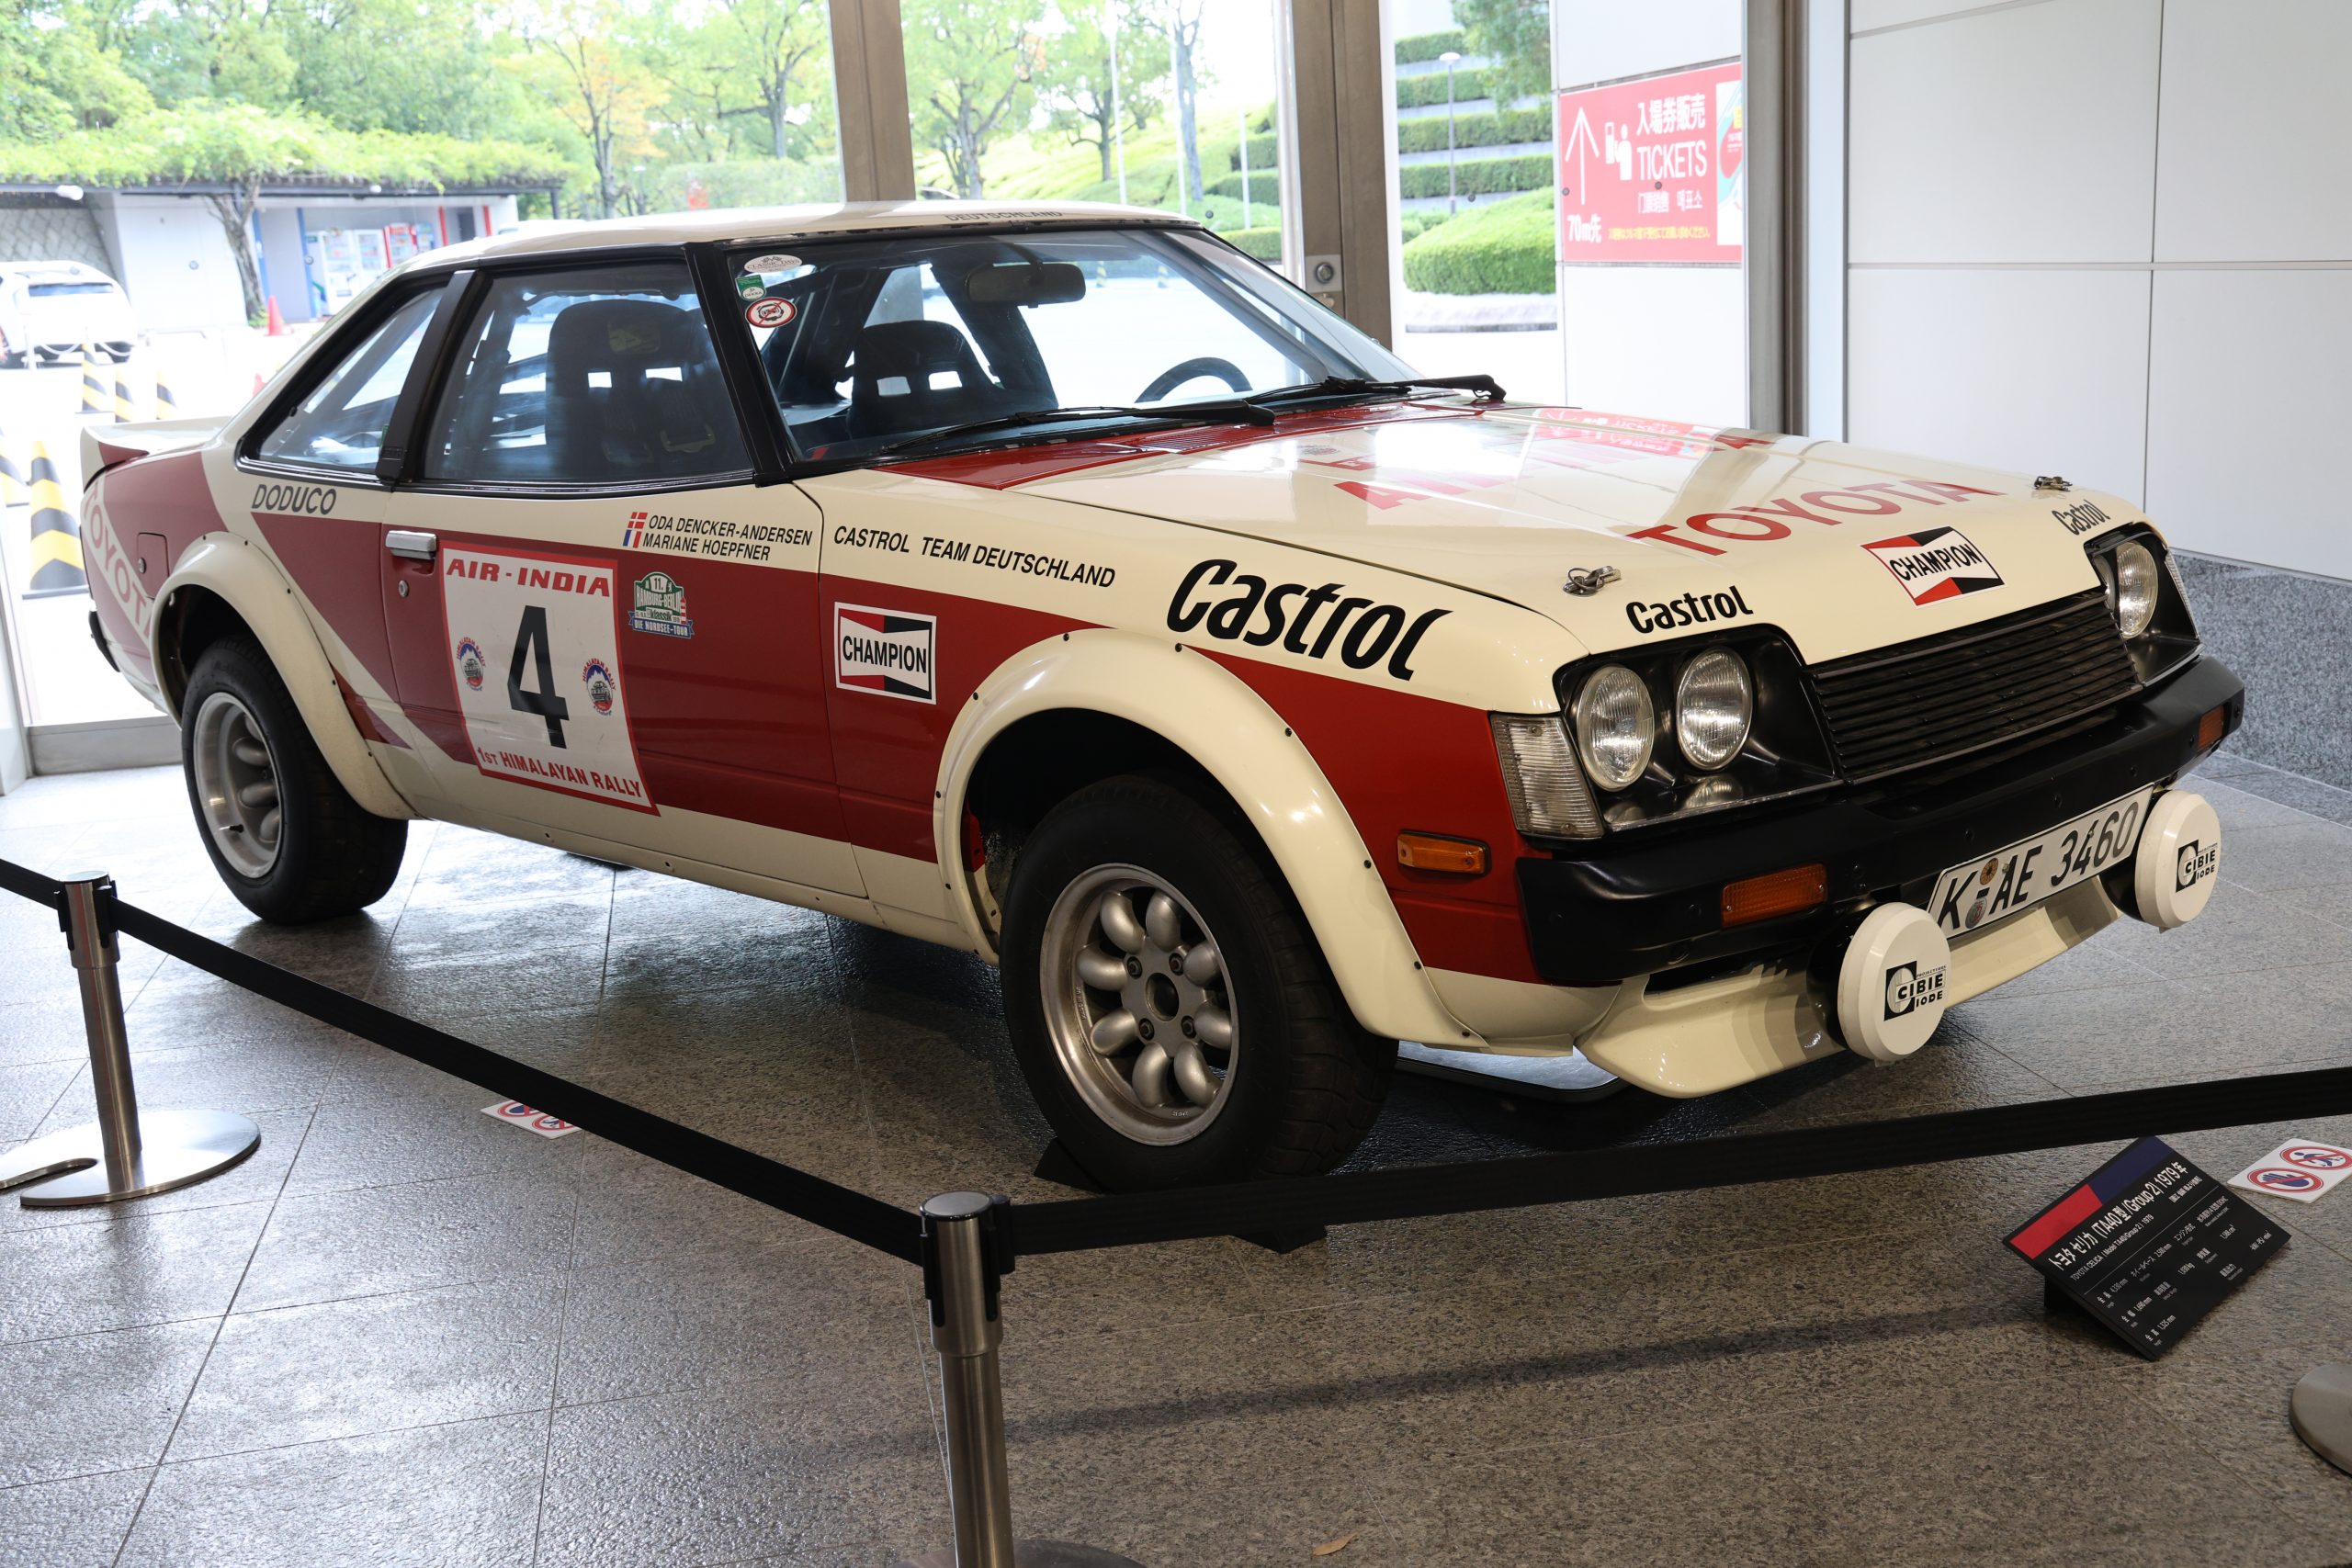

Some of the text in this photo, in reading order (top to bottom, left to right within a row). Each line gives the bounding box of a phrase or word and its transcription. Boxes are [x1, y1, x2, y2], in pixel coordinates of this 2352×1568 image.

[1636, 93, 1705, 135] 入場券販売
[1636, 140, 1707, 180] TICKETS
[944, 210, 1063, 221] DEUTSCHLAND
[252, 484, 336, 514] DODUCO
[1625, 479, 2008, 557] TOYOTA
[2052, 499, 2111, 536] Castrol
[643, 533, 770, 561] MARIANE HOEPFNER
[649, 514, 813, 546] ODA DENCKER-ANDERSEN
[84, 480, 151, 639] TOYOT
[834, 525, 1115, 588] CASTROL TEAM DEUTSCHLAND
[1890, 543, 1983, 581] CHAMPION
[1166, 558, 1454, 682] Castrol
[1626, 585, 1754, 634] Castrol
[842, 636, 926, 673] CHAMPION
[507, 605, 570, 750] 4
[499, 751, 590, 786] HIMALAYAN
[590, 771, 642, 797] RALLY
[2051, 801, 2139, 886] 3460
[2186, 850, 2215, 874] CIBIE
[2197, 864, 2215, 879] IODE
[1898, 974, 1943, 999] CIBIE
[1916, 990, 1943, 1008] IODE
[2048, 1248, 2075, 1270] トヨタ
[2069, 1232, 2098, 1253] セリカ
[2070, 1266, 2089, 1280] TOYOTA
[2086, 1255, 2103, 1268] CELICA
[2142, 1214, 2154, 1224] 1979
